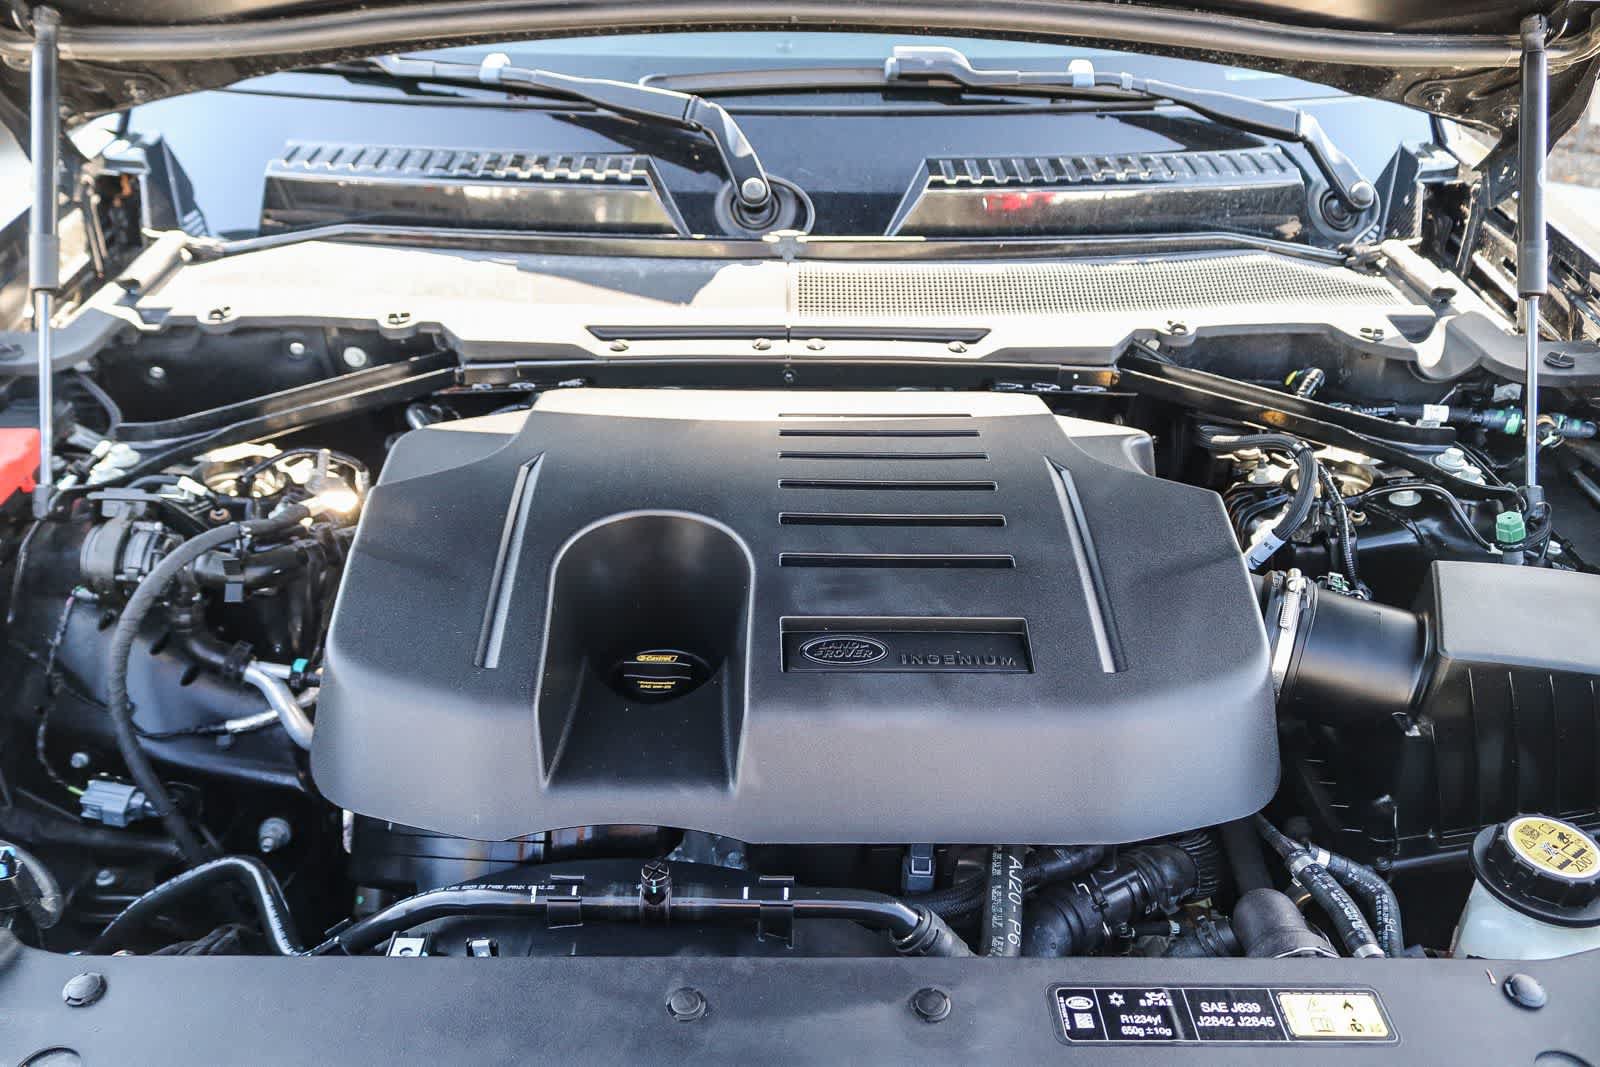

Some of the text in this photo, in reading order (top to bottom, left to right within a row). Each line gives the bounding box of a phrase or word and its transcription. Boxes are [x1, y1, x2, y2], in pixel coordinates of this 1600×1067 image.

[820, 648, 873, 658] ROVER
[901, 654, 1017, 666] INGENIUM
[1200, 1001, 1261, 1014] SAE J639
[1120, 1014, 1162, 1026] R1234yf
[1197, 1015, 1276, 1028] J2842 J2845
[1121, 1025, 1145, 1037] 650g
